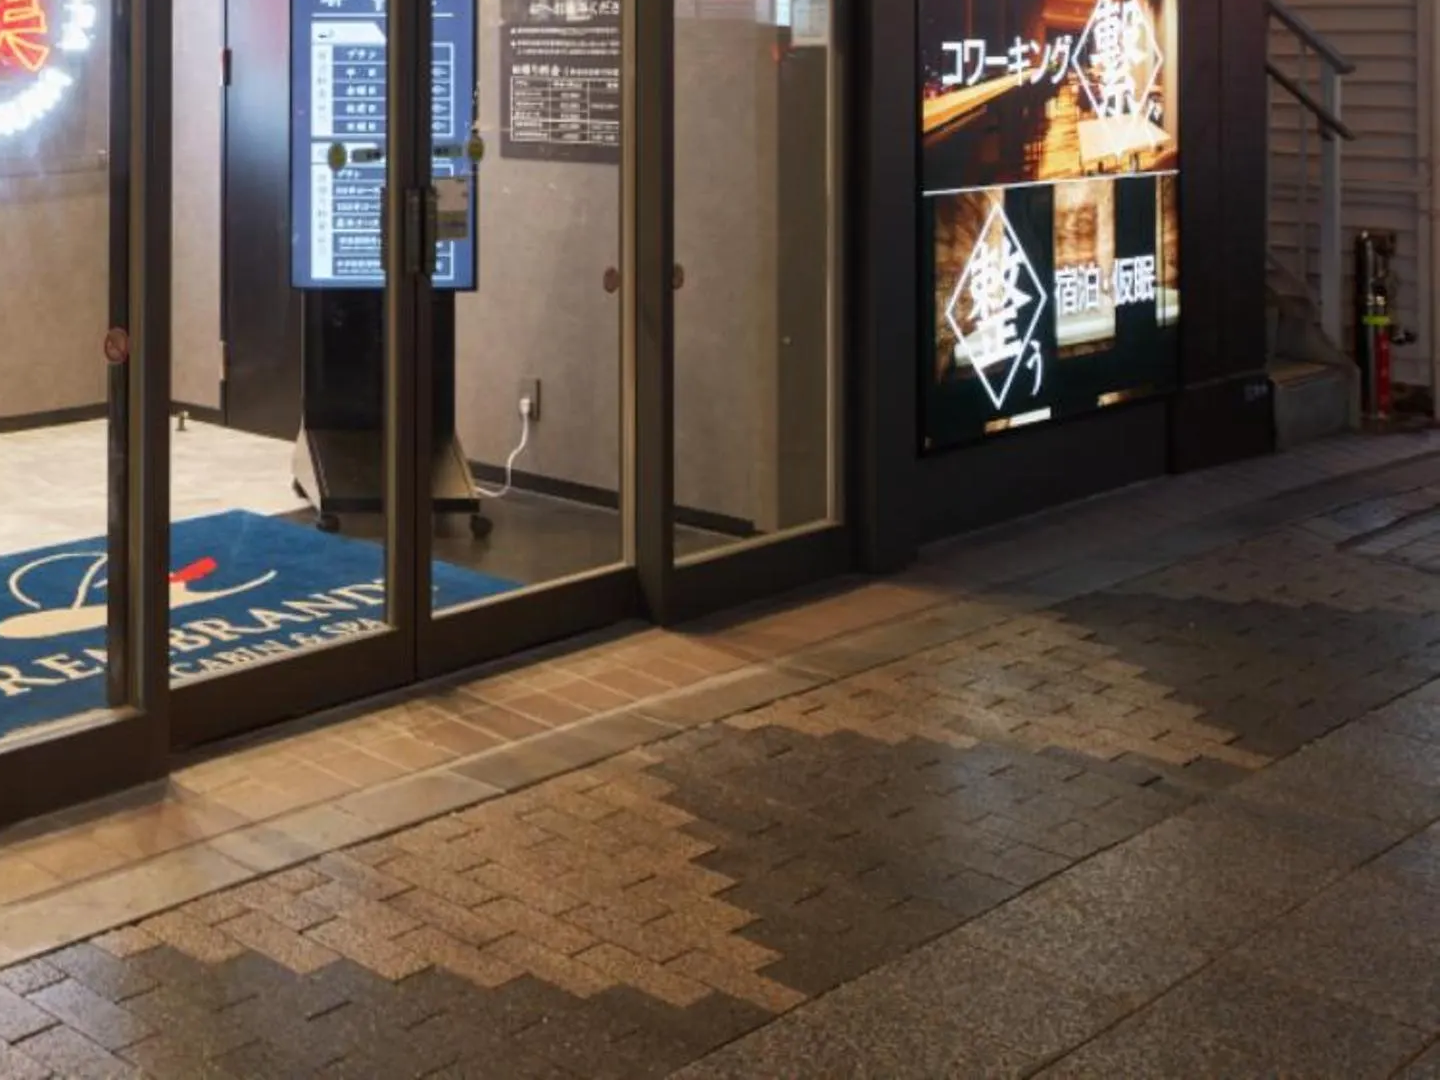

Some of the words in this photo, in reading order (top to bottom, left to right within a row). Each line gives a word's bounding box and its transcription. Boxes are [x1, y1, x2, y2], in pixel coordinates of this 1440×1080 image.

[941, 34, 1073, 87] コワーキング
